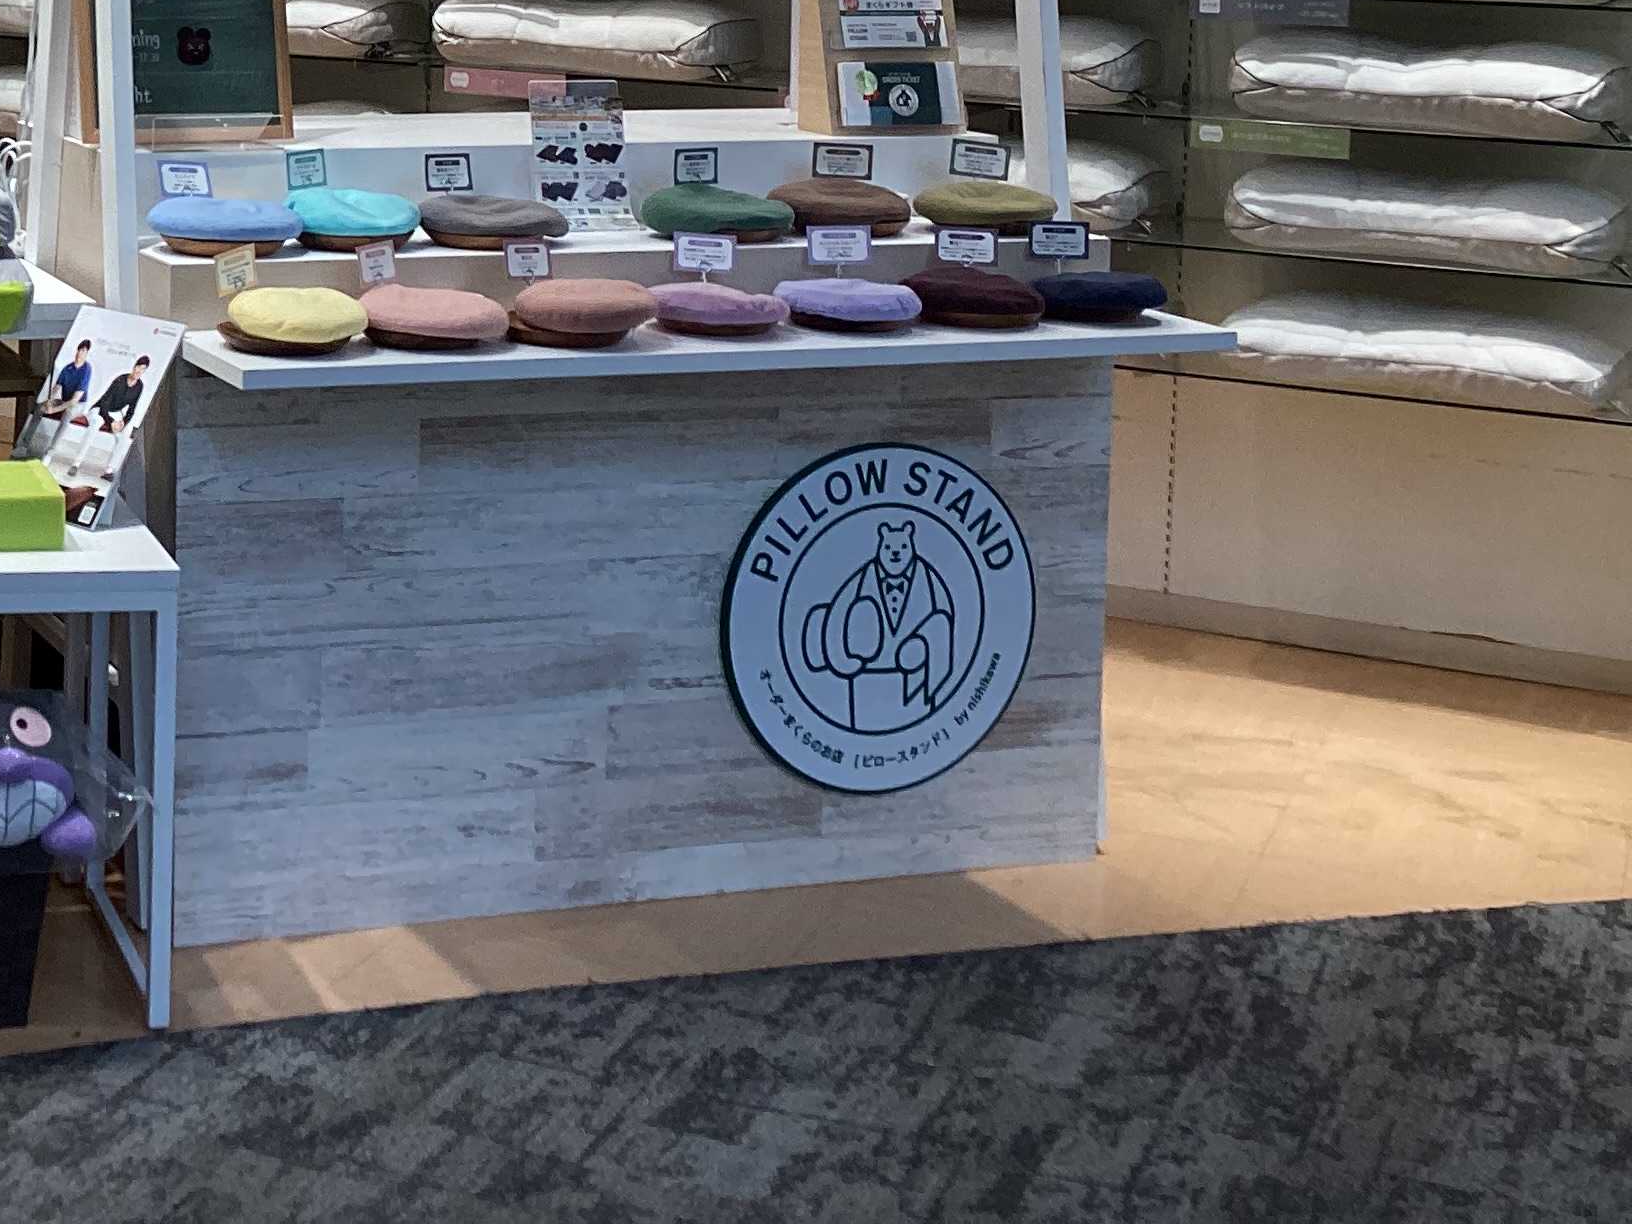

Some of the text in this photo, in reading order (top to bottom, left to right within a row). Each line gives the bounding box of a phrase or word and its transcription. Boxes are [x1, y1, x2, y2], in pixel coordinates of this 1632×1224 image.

[751, 458, 1014, 582] PILLOW STAND
[759, 669, 845, 764] オーダーまくらのお店
[953, 652, 1002, 726] by nishikawa
